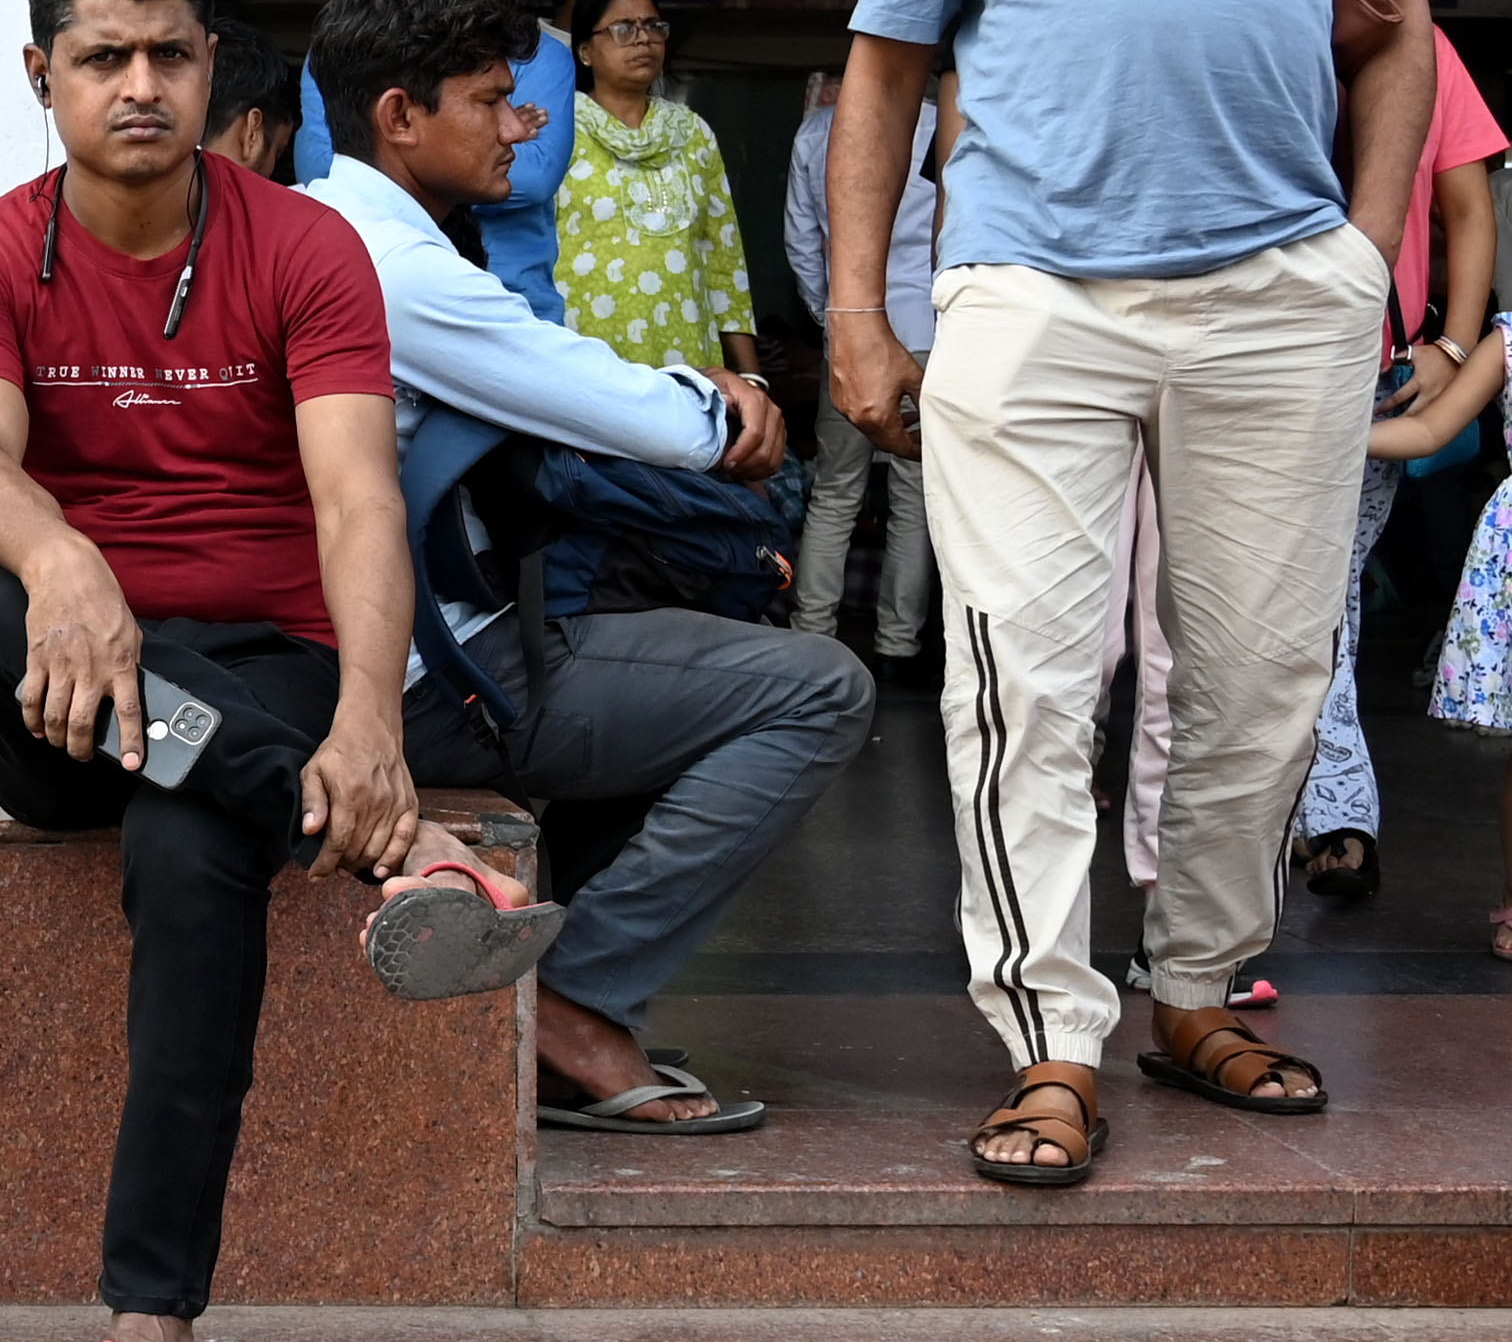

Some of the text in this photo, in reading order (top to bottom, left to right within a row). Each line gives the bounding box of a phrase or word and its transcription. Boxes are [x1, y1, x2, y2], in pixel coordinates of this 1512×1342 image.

[36, 362, 256, 382] TRUE WINNER NEVER QUIT
